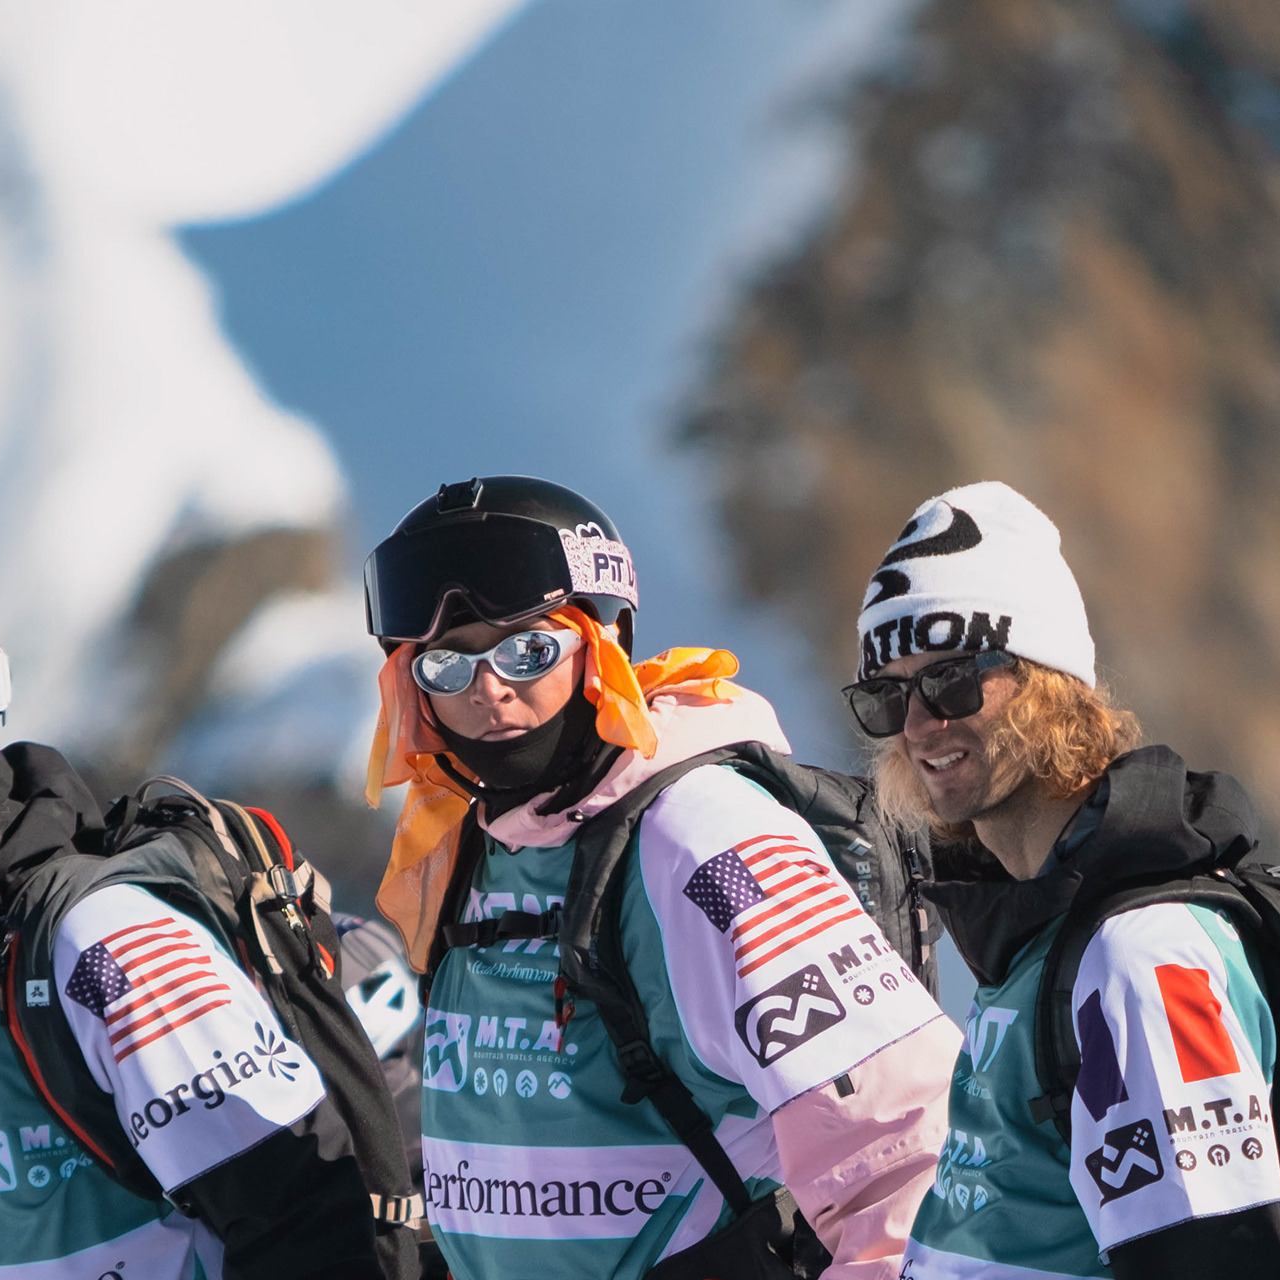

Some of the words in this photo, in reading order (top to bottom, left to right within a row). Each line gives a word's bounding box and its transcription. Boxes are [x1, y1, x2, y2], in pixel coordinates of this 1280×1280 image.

[857, 611, 1013, 682] ATION
[855, 860, 876, 908] Blac
[474, 1015, 579, 1056] M.T.A.
[128, 1049, 262, 1149] eorgia
[1162, 1094, 1270, 1136] M.T.A.
